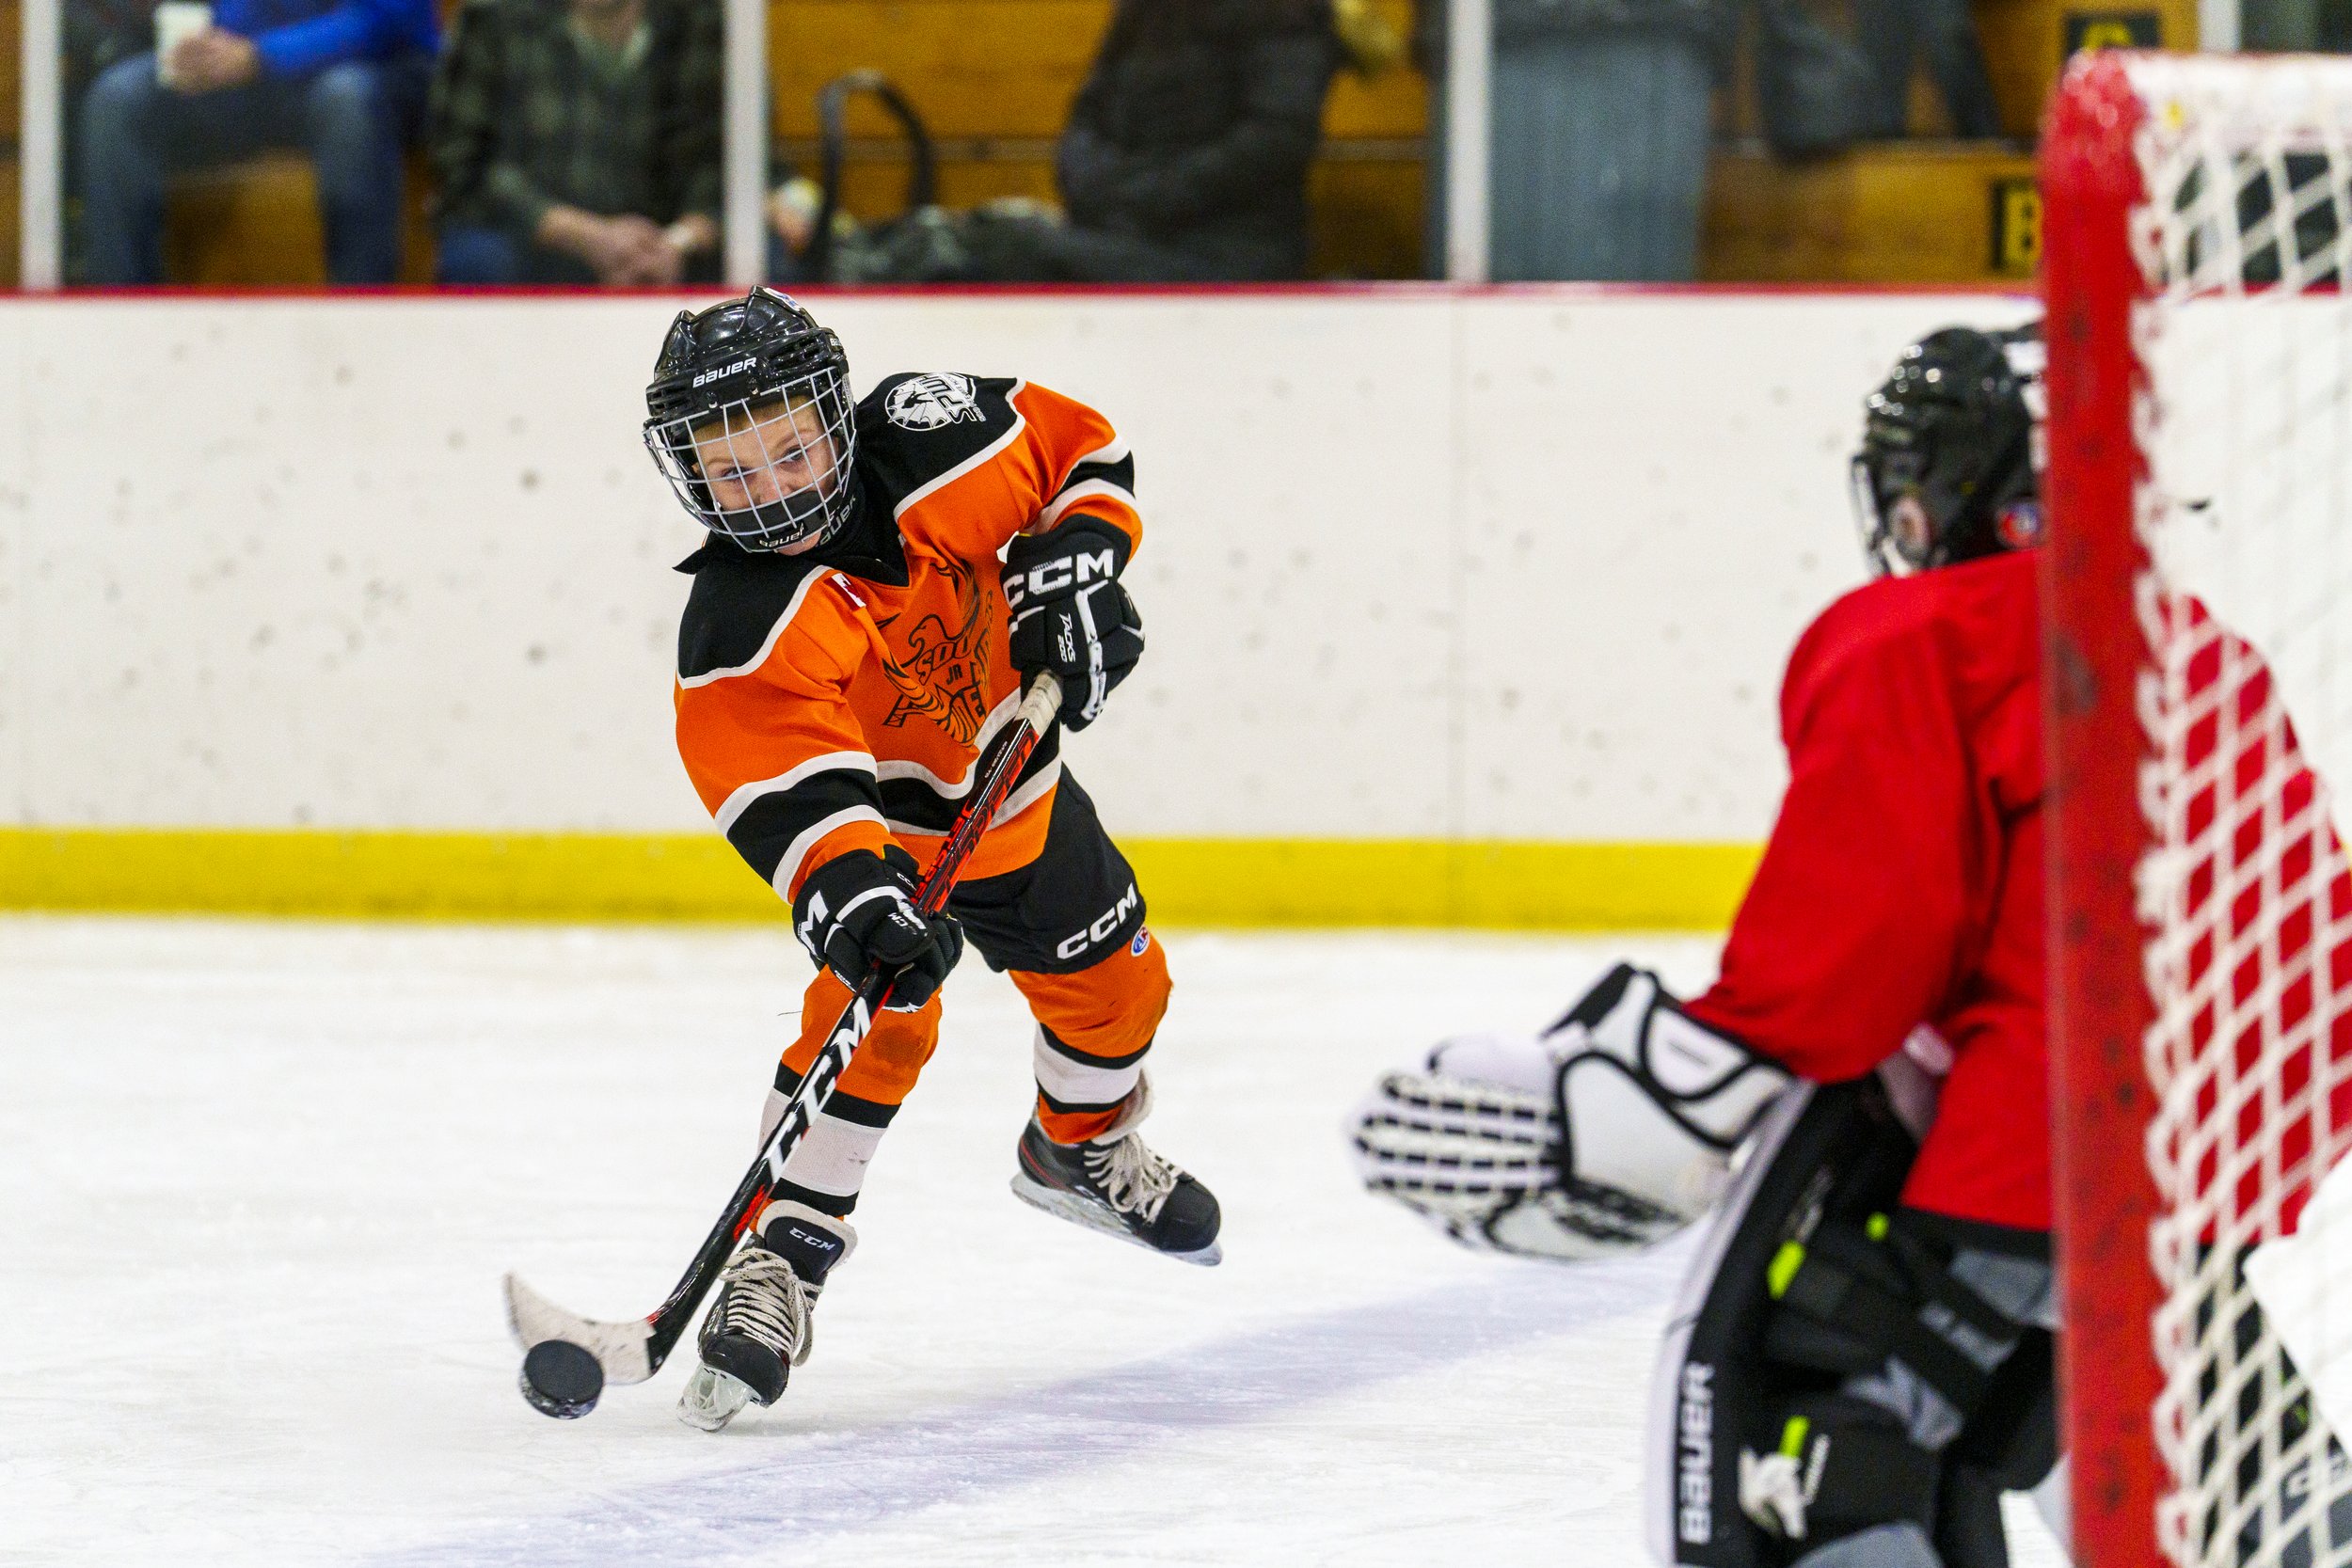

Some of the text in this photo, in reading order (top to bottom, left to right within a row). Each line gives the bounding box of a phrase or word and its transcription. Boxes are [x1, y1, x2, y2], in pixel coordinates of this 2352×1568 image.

[692, 356, 757, 388] BAUER
[1003, 548, 1114, 610] CCM
[1058, 612, 1076, 663] TACKS
[946, 663, 963, 686] JR
[1057, 882, 1137, 959] CCM
[764, 996, 872, 1184] CCM
[788, 1226, 836, 1251] CCM
[1680, 1361, 1715, 1544] BAUER
